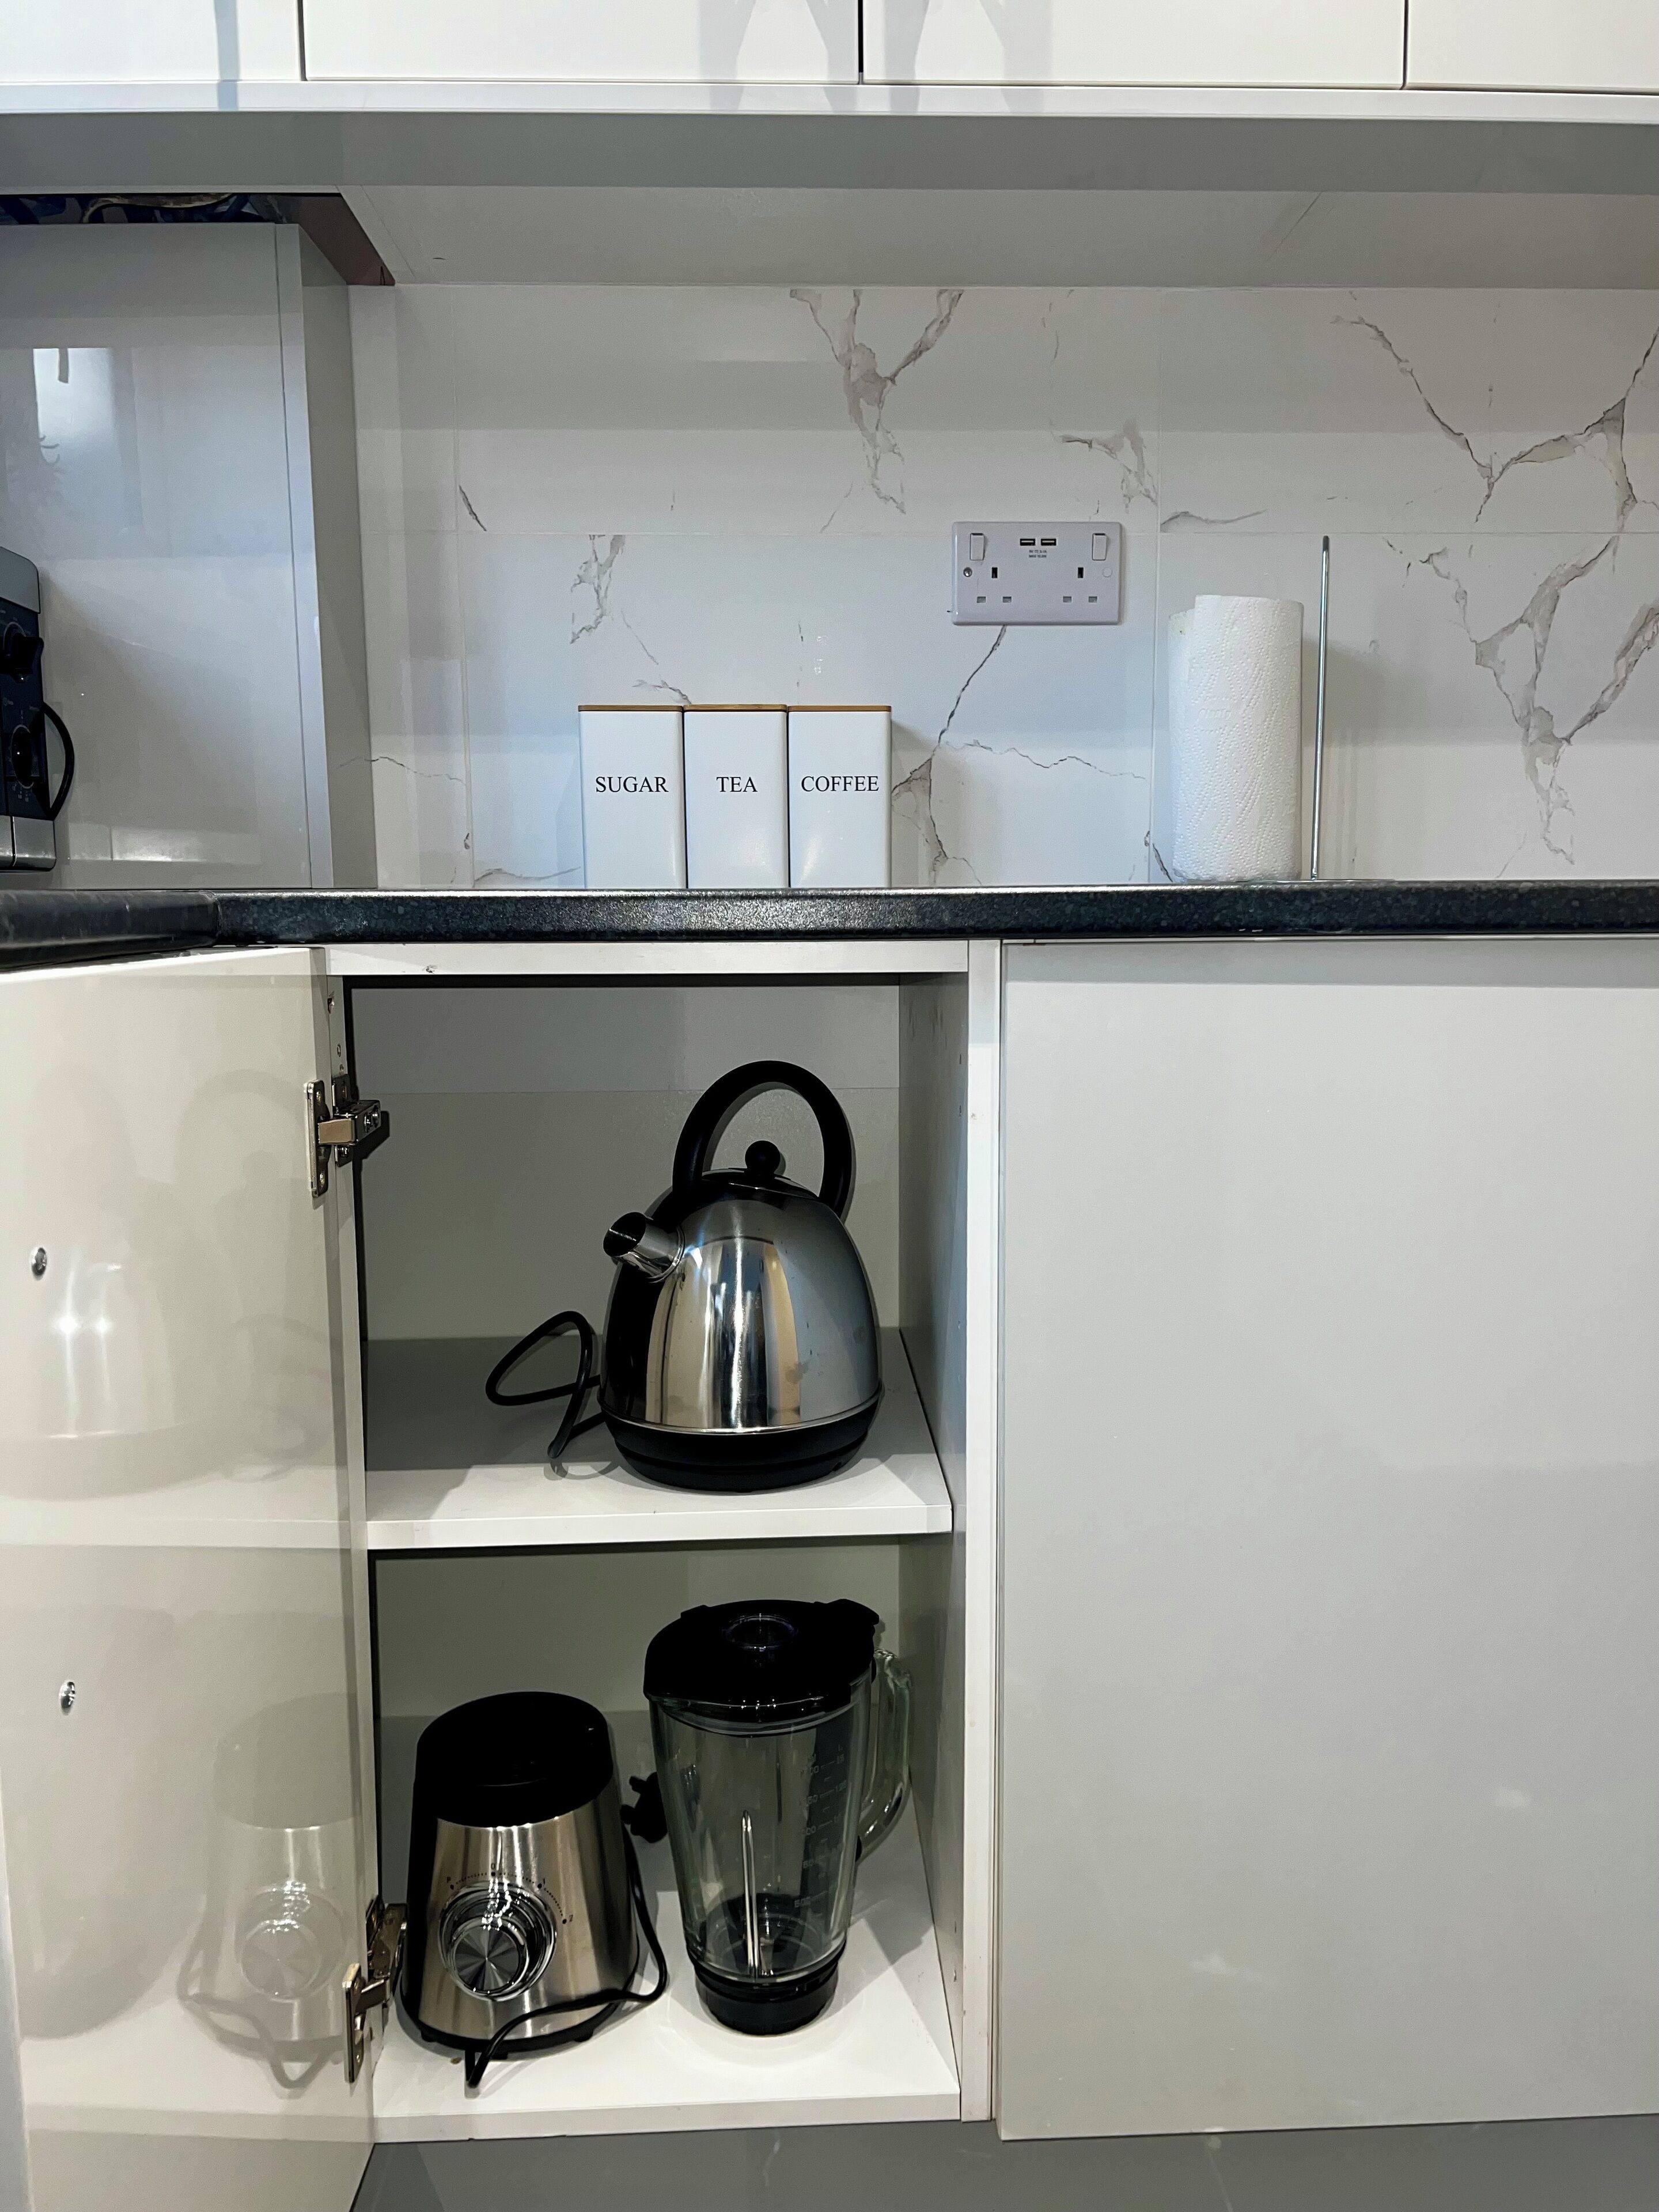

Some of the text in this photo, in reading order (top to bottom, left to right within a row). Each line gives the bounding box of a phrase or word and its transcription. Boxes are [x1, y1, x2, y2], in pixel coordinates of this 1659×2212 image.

[595, 776, 669, 793] SUGAR
[716, 777, 758, 793] TEA
[801, 775, 879, 792] COFFEE
